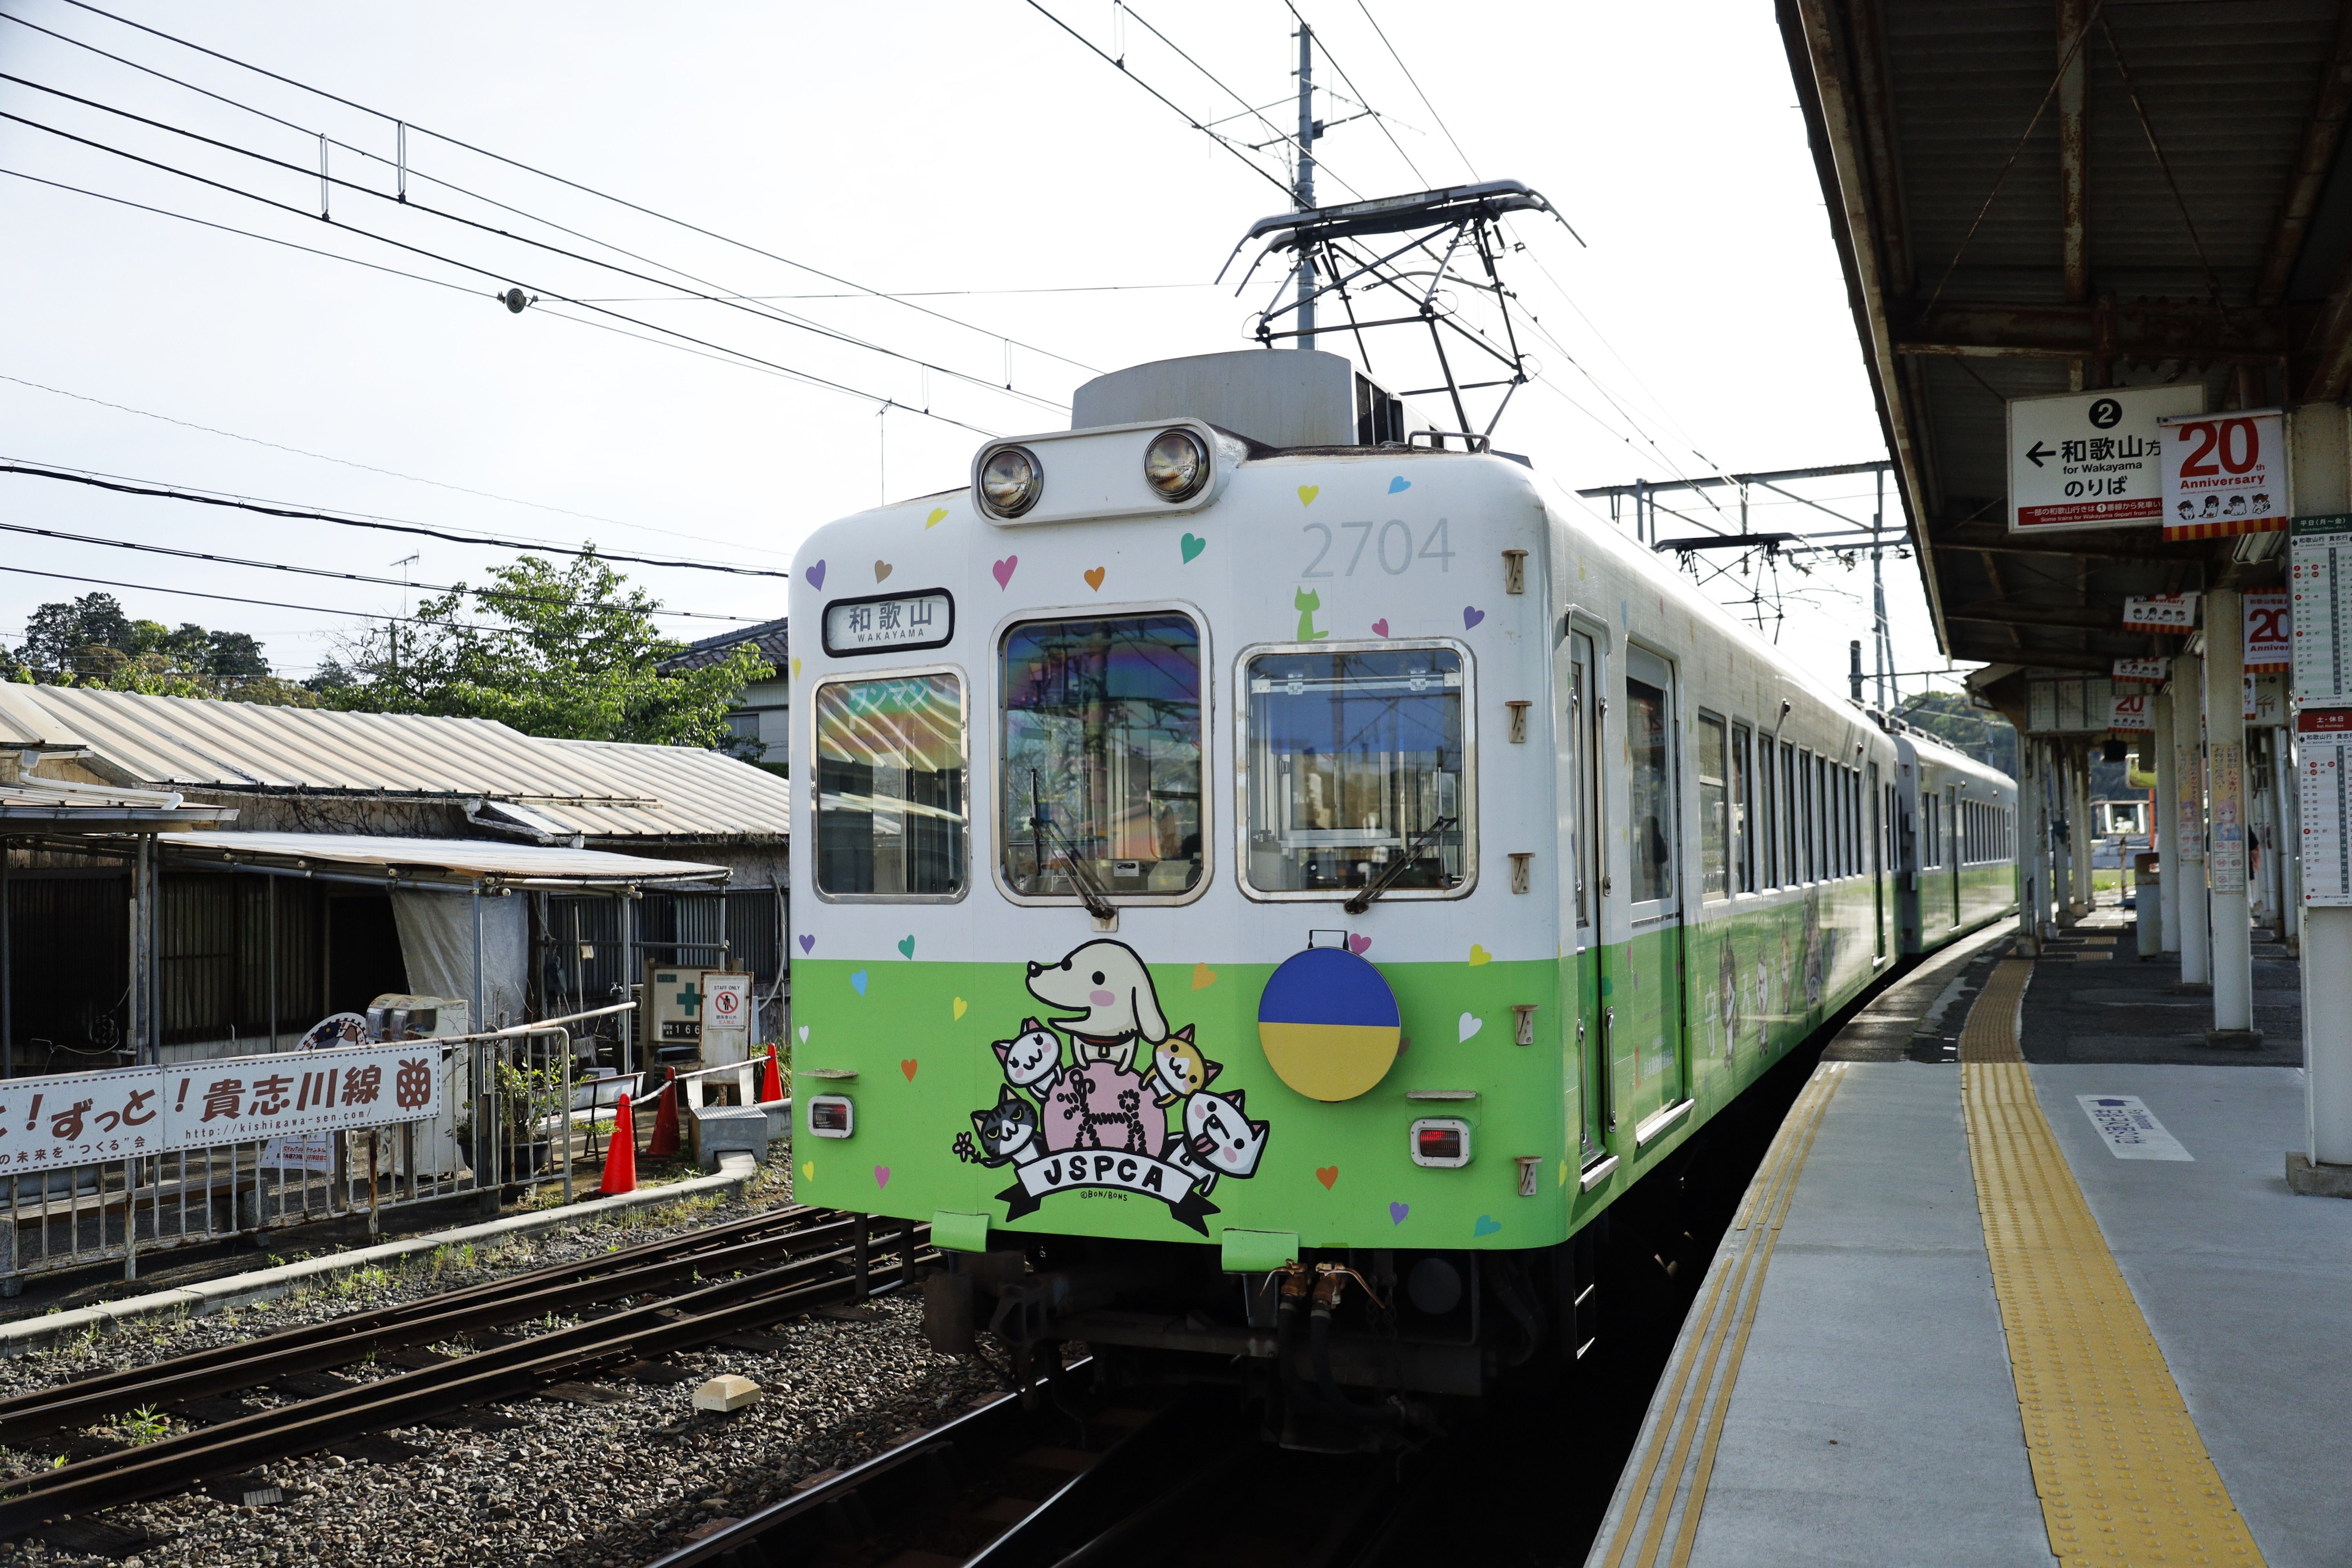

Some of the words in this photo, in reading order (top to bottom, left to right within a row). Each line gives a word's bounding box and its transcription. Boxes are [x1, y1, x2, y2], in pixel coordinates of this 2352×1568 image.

[2098, 403, 2114, 423] 2
[2062, 435, 2160, 463] 和歌山方
[2179, 417, 2259, 478] 20
[2063, 465, 2078, 474] for
[2082, 462, 2143, 473] Wakayama
[2180, 475, 2265, 489] Anniversary
[2064, 475, 2128, 497] のりば
[1301, 517, 1455, 578] 2704
[848, 599, 932, 633] 和歌山
[858, 628, 924, 642] WAKAYAMA
[851, 684, 928, 712] ワンマン
[0, 1065, 382, 1141] !ずっと!貴志川線
[185, 1108, 372, 1140] http://kishigawa-sen.com/
[1044, 1159, 1164, 1193] JSPCA
